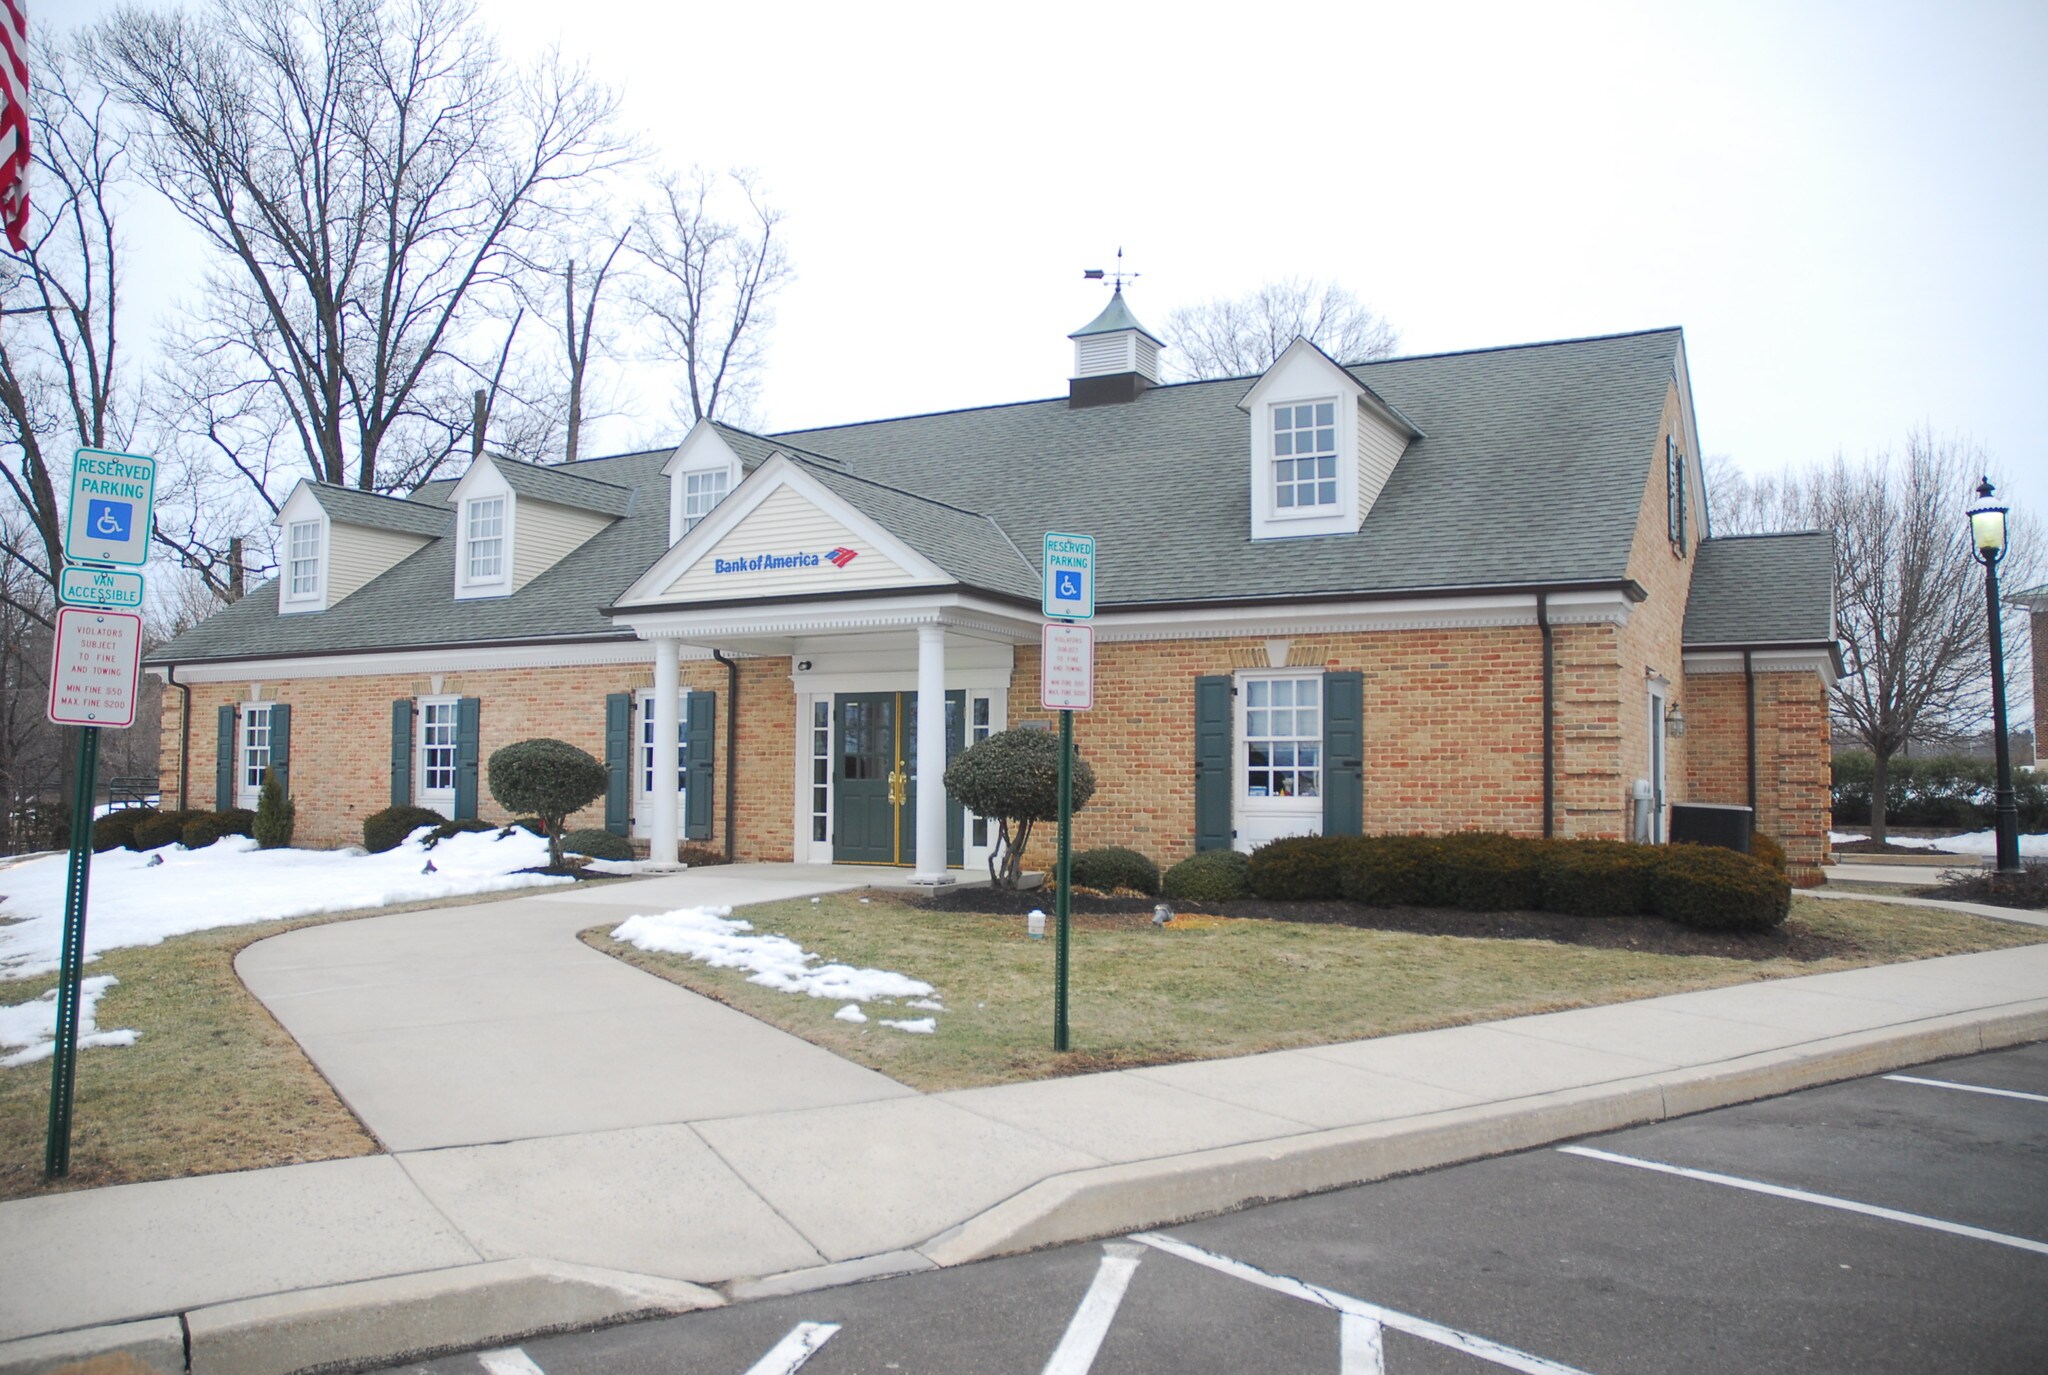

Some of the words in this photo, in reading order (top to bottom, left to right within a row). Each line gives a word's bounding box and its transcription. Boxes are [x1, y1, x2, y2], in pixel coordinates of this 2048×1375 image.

[78, 458, 151, 481] RESERVED
[81, 478, 144, 499] PARKING
[1047, 540, 1091, 555] RESERVED
[715, 556, 747, 574] Bank
[750, 554, 763, 571] of
[764, 552, 819, 570] America
[1050, 555, 1088, 568] PARKING
[93, 575, 114, 587] VAN
[68, 586, 136, 602] ACCESSIBLE
[77, 626, 123, 637] VIOLATORS
[80, 640, 116, 650] SUBJECT
[79, 652, 90, 661] TO
[96, 654, 116, 663] FINE
[71, 665, 88, 674] AND
[93, 666, 121, 676] TOWING
[84, 685, 102, 695] FINE
[83, 698, 100, 707] FINE
